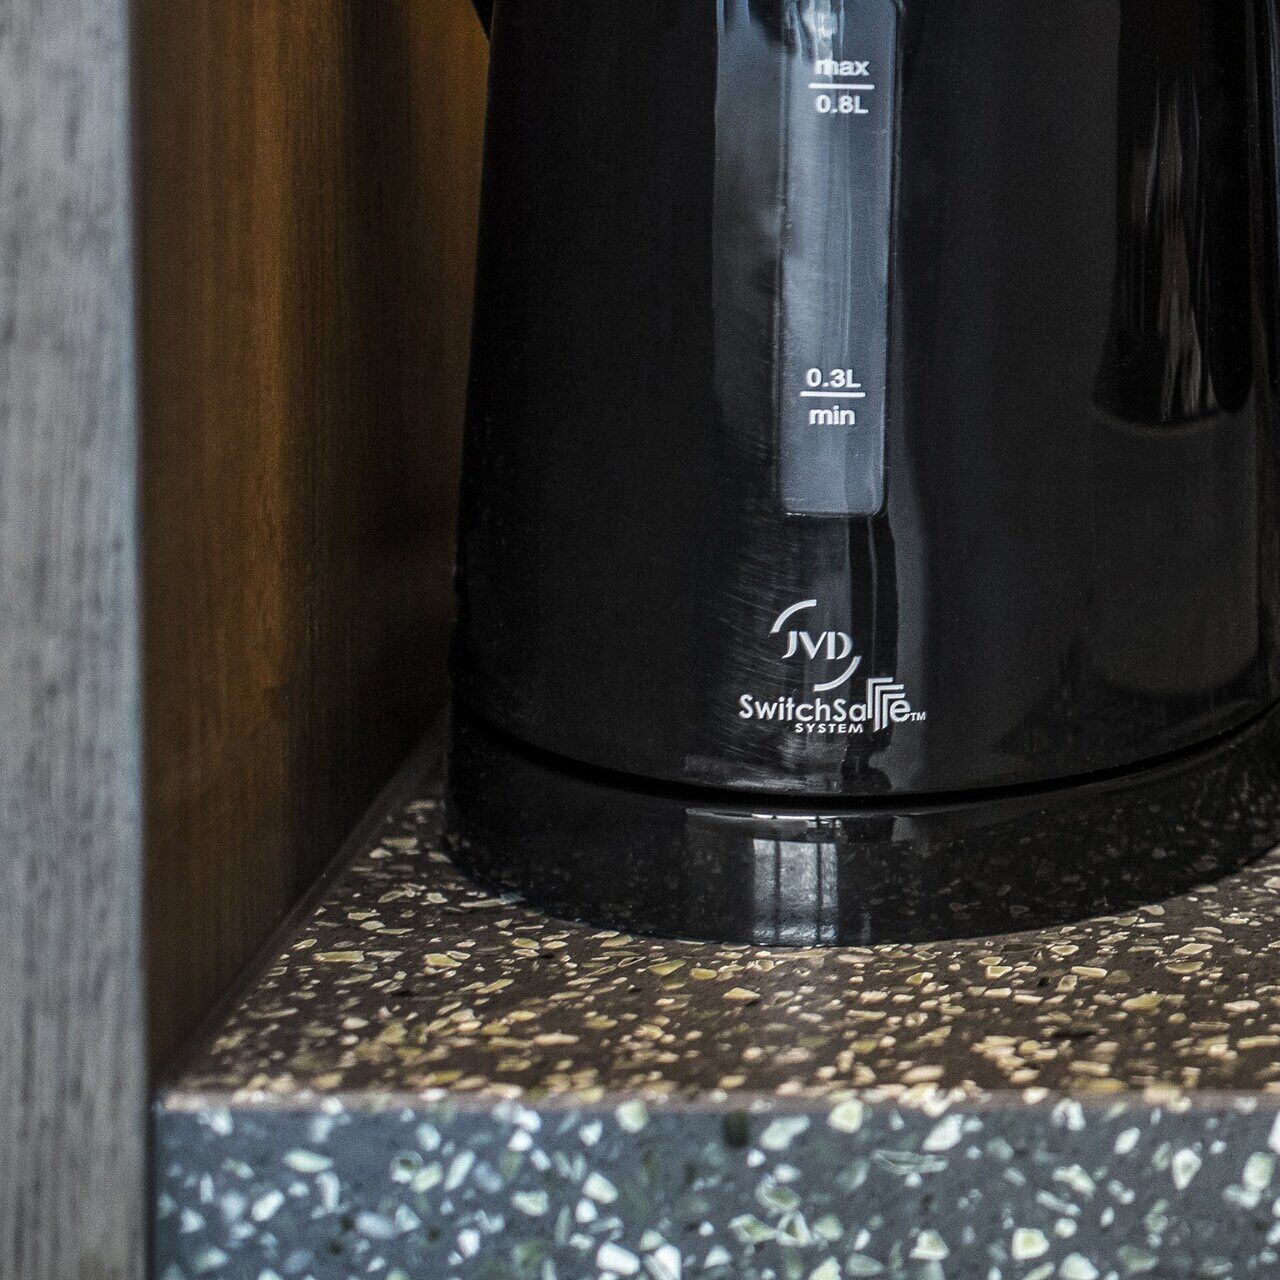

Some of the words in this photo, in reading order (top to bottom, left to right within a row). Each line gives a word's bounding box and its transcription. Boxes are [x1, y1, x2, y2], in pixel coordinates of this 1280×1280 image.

[814, 60, 870, 76] max
[816, 94, 869, 114] 0.8L
[806, 367, 862, 388] 0.3L
[808, 405, 856, 426] min
[781, 630, 854, 660] JVD
[794, 722, 864, 734] SYSTEM
